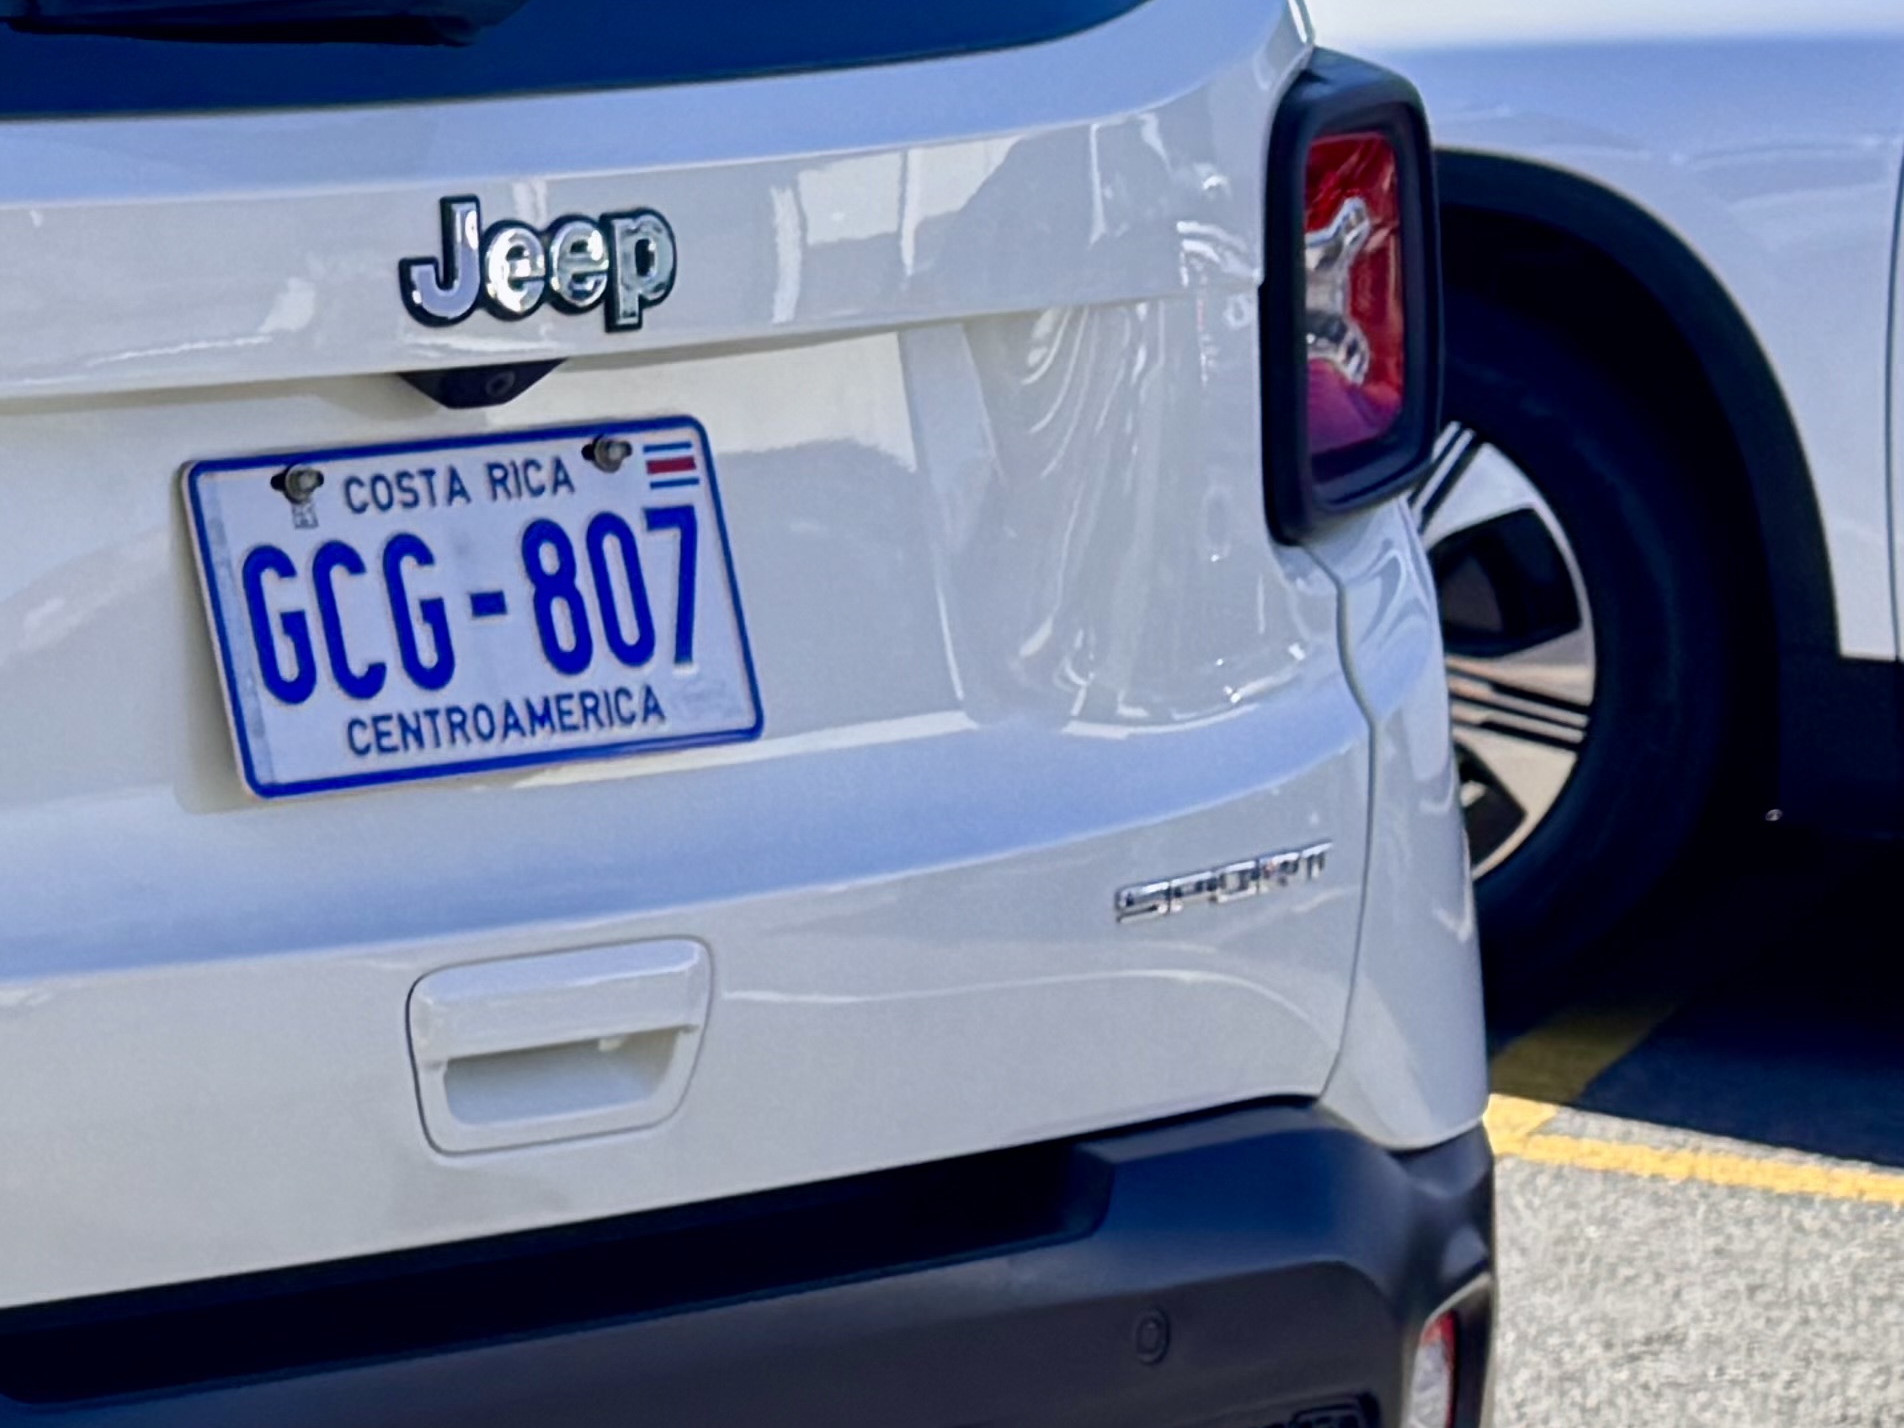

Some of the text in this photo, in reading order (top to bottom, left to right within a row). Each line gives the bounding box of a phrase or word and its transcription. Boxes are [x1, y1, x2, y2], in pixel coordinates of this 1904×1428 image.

[398, 194, 677, 332] Jeep
[343, 456, 576, 514] COSTA RICA
[241, 503, 700, 706] GCG-807
[346, 683, 667, 758] CENTROAMERICA
